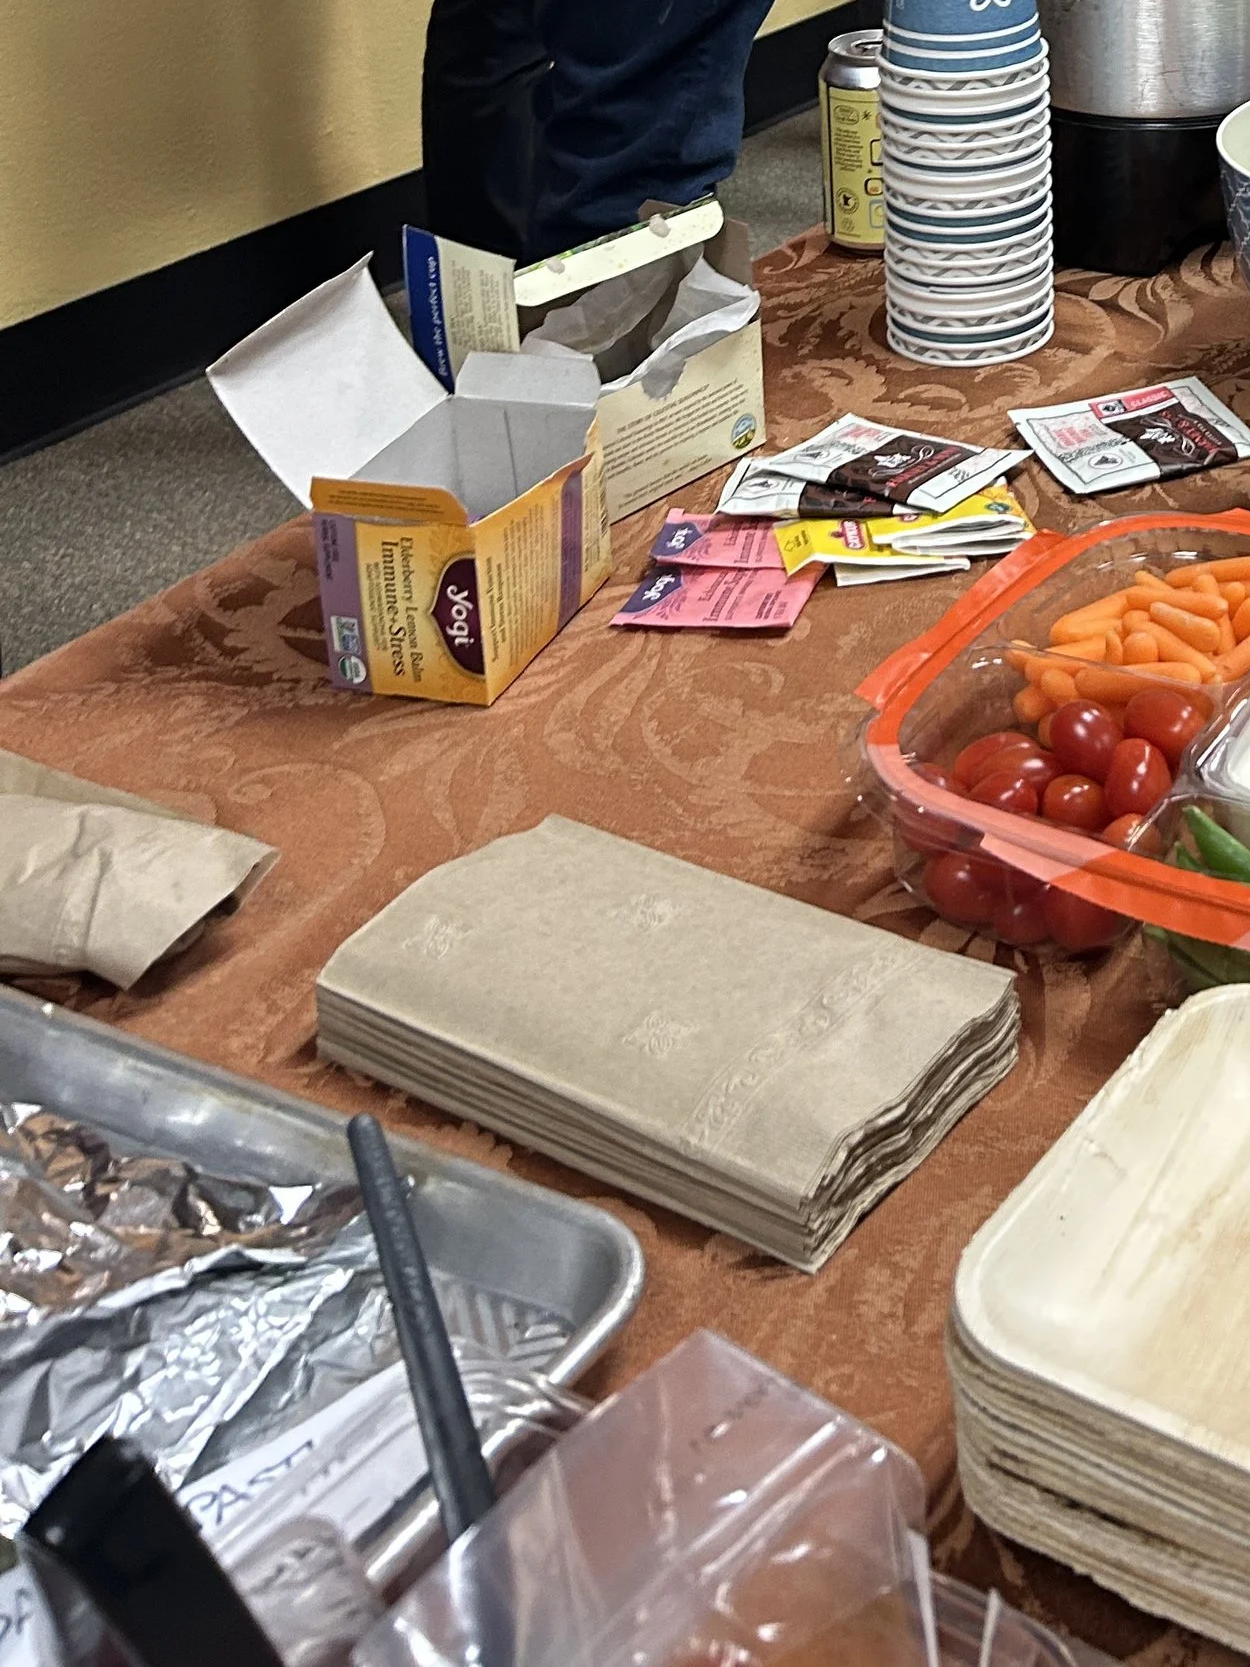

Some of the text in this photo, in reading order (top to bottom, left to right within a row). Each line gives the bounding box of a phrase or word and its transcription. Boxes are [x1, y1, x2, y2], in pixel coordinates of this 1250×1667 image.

[399, 537, 424, 683] Elderberry Lemon Balm
[445, 585, 475, 645] yogi
